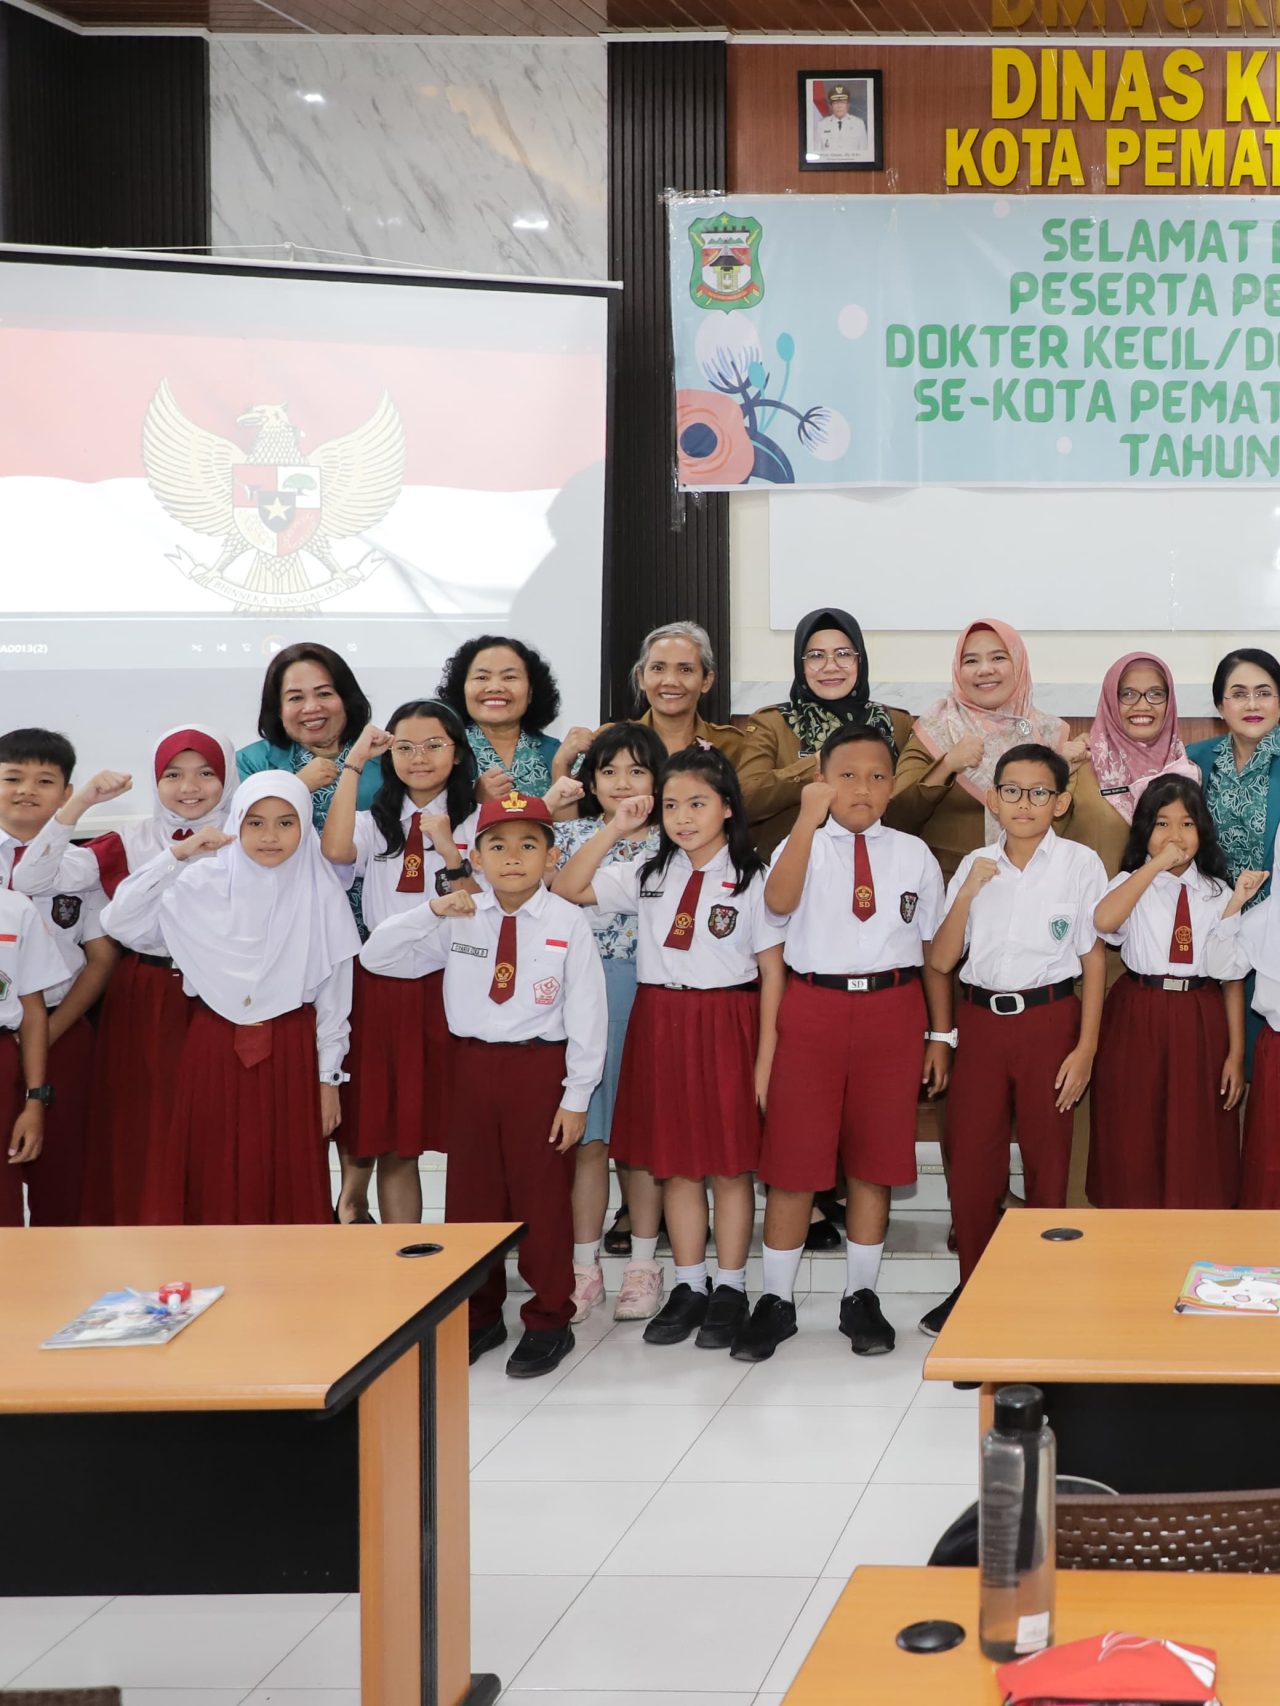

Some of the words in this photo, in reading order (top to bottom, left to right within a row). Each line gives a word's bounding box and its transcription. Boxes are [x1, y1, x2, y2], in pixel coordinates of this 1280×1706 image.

[992, 48, 1206, 122] DINAS
[945, 128, 1085, 187] KOTA
[1042, 218, 1259, 263] SELAMAT
[1009, 272, 1217, 317] PESERTA
[885, 324, 1069, 369] DOKTER
[914, 378, 1117, 423] SE-KOTA
[1120, 434, 1280, 479] TAHUN
[406, 870, 419, 878] SD
[673, 928, 685, 936] SD
[1179, 944, 1189, 952] SD
[851, 980, 864, 989] SD
